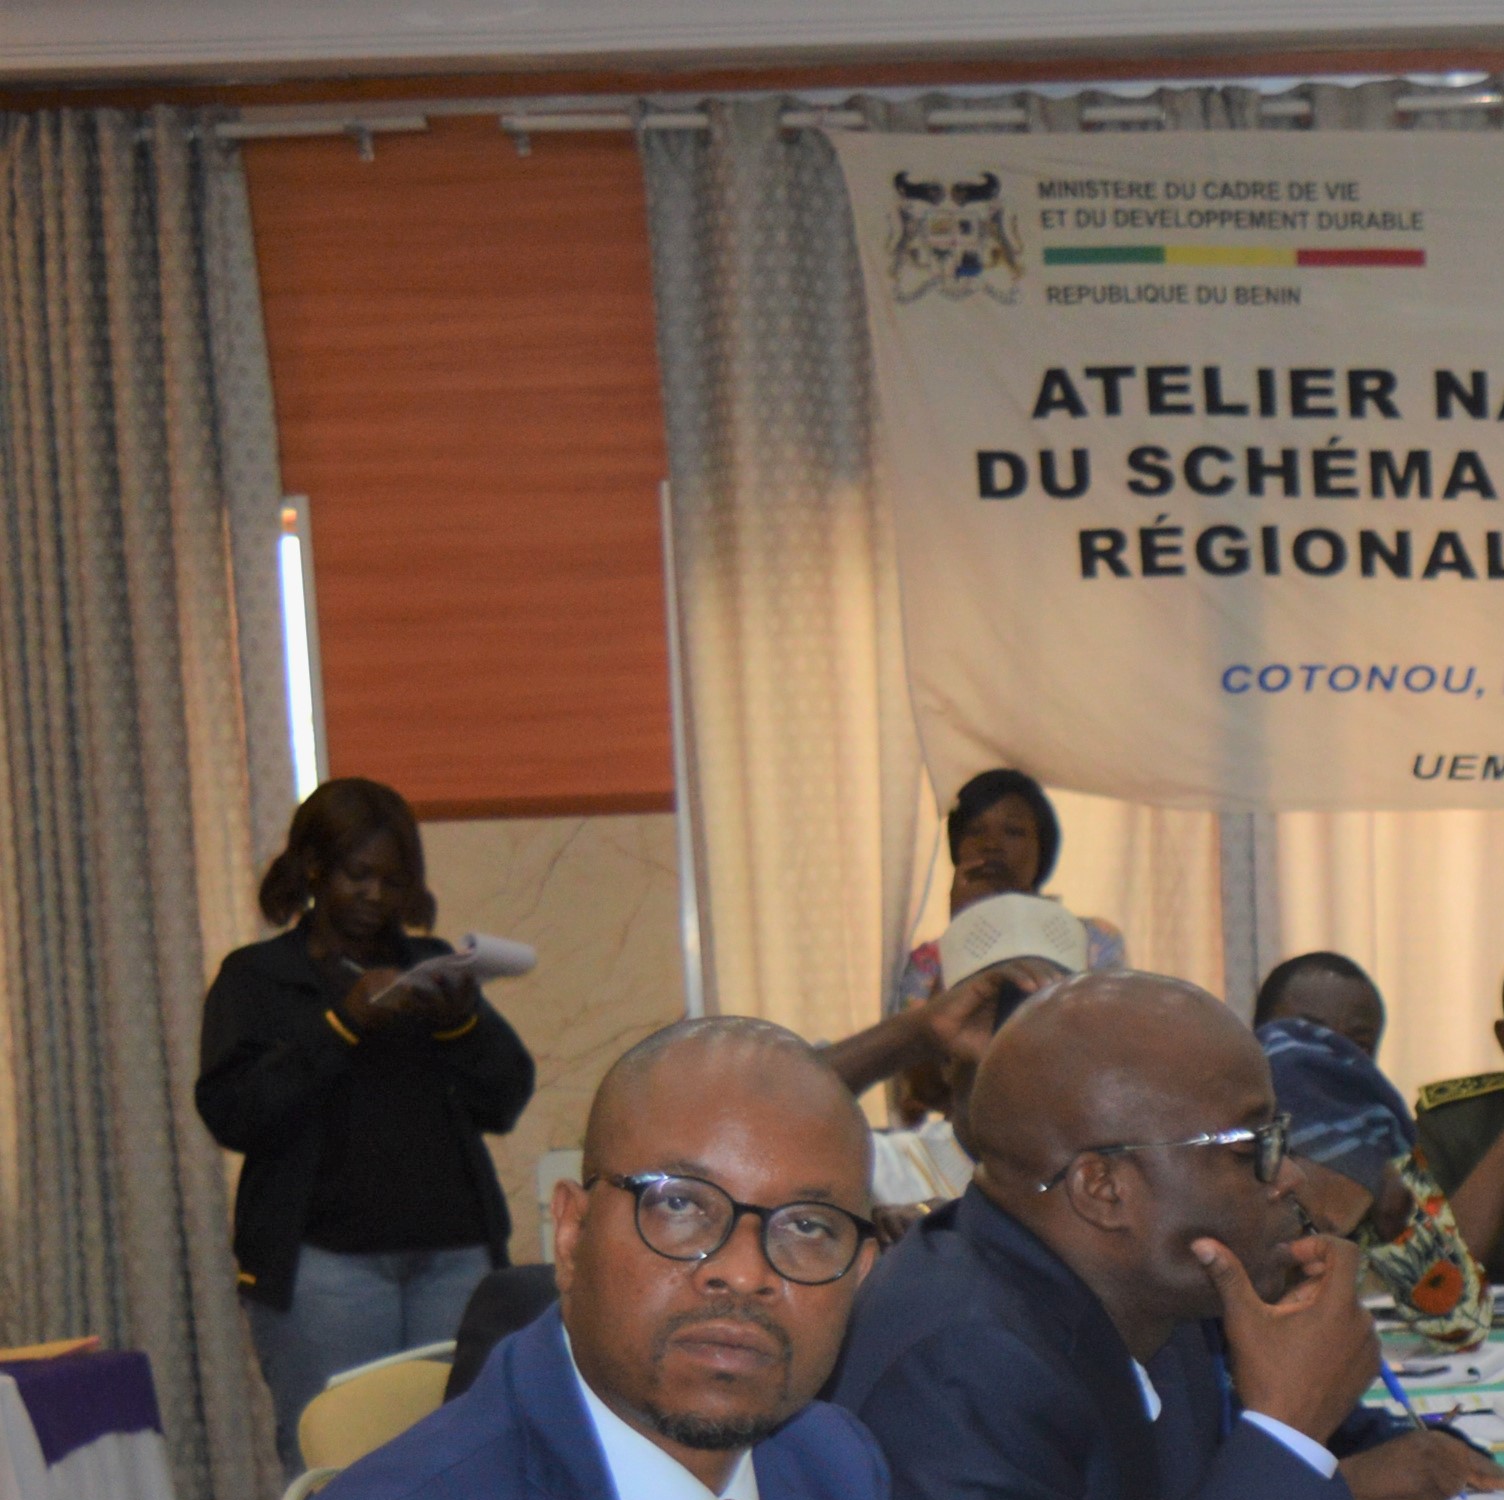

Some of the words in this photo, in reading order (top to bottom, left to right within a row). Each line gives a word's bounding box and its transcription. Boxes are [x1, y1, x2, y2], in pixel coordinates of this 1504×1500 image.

[1037, 178, 1157, 201] MINISTERE
[1164, 180, 1196, 200] DU
[1202, 180, 1280, 201] CADRE
[1287, 181, 1316, 201] DE
[1324, 181, 1359, 202] VIE
[1039, 209, 1066, 229] ET
[1074, 208, 1106, 229] DU
[1112, 207, 1309, 230] DEVELOPPEMENT
[1317, 210, 1423, 231] DURABLE
[1045, 283, 1188, 306] REPUBLIQUE
[1195, 284, 1227, 305] DU
[1233, 285, 1301, 306] BENIN
[1031, 364, 1401, 420] ATELIER
[975, 447, 1091, 501] DU
[1125, 435, 1498, 501] SCHÉMA
[1220, 663, 1484, 700] COTONOU,
